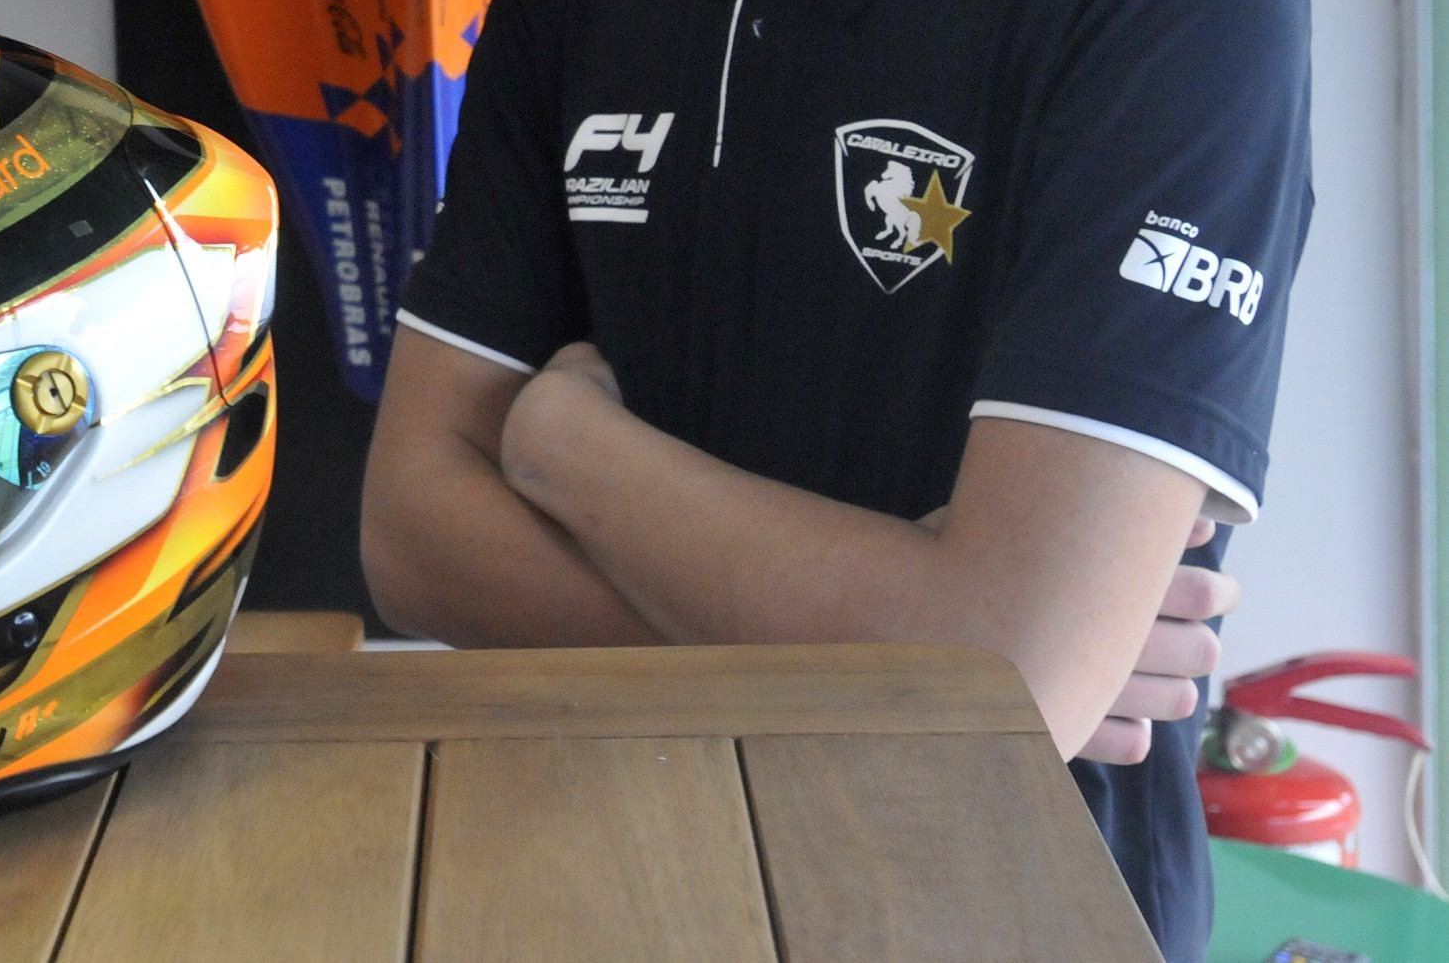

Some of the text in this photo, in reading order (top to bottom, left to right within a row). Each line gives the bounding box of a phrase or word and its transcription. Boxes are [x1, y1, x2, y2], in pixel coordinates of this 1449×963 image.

[563, 112, 676, 173] F4
[846, 133, 962, 169] CAVALEIRO
[565, 177, 651, 194] RAZILIAN
[1144, 209, 1199, 238] banco
[321, 176, 373, 368] PETROBRAS
[364, 199, 394, 338] RENAULT
[861, 246, 922, 267] SPORTS
[1172, 244, 1264, 326] BRB
